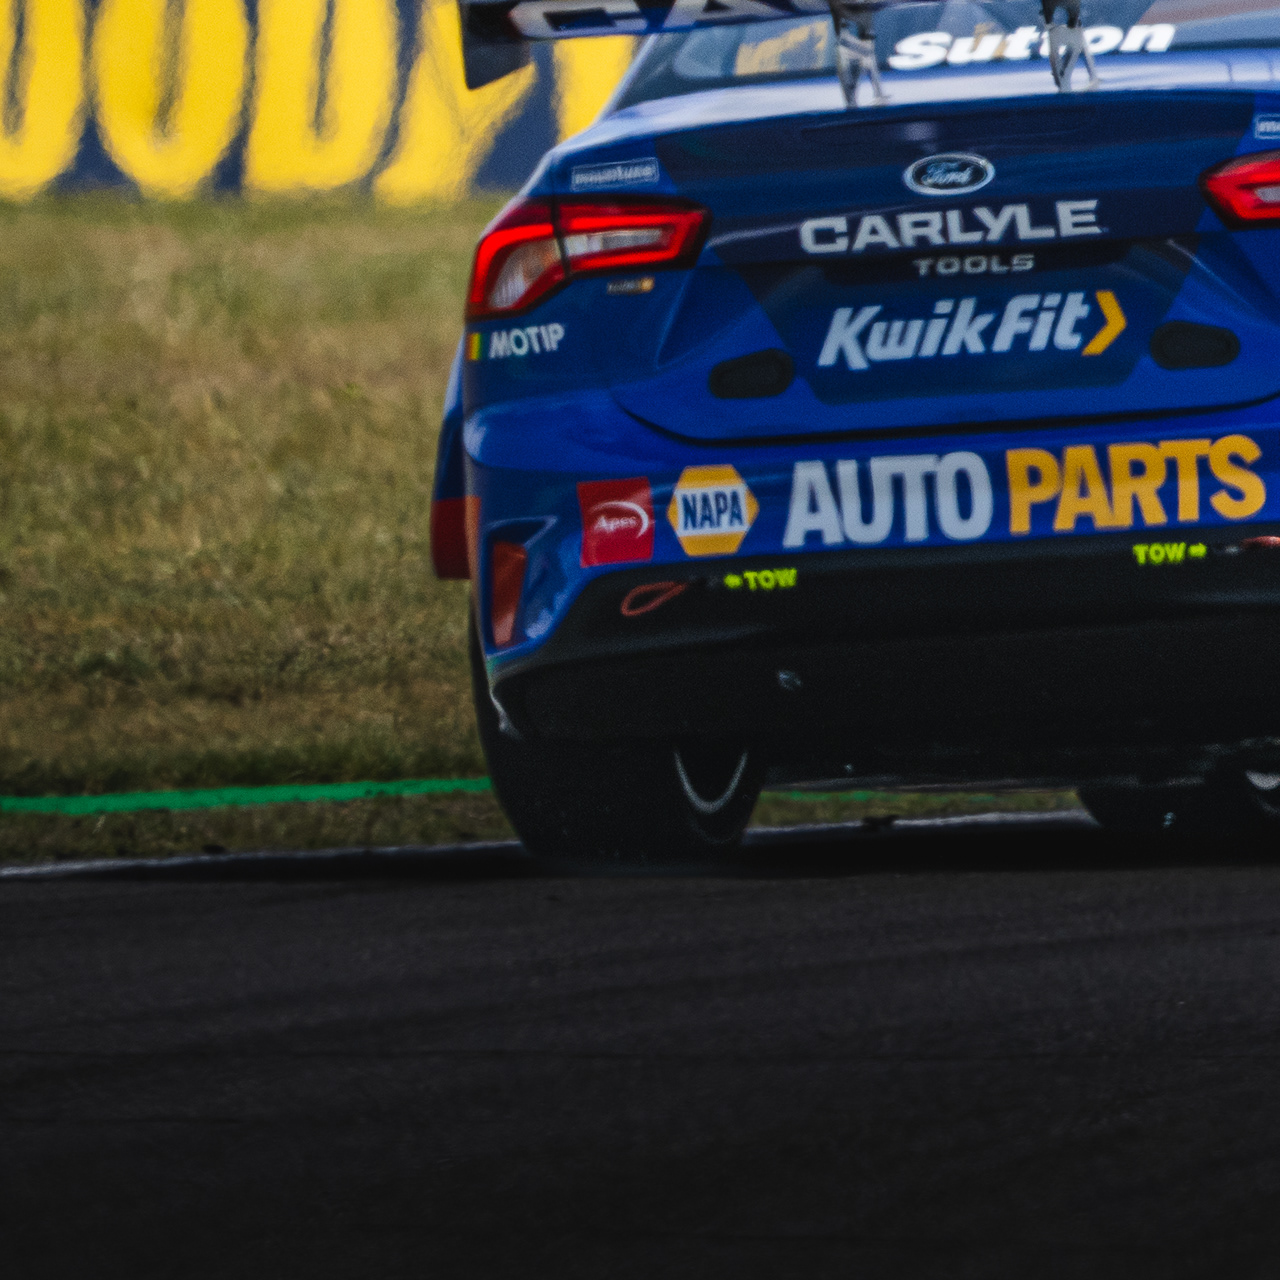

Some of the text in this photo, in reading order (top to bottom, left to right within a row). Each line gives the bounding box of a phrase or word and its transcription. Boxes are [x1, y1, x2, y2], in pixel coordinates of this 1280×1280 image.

[920, 161, 975, 186] Ford
[800, 199, 1102, 254] CARLYLE
[913, 253, 1036, 277] TOOLS
[488, 324, 566, 359] MOTIP
[783, 435, 1266, 548] AUTO PARTS
[682, 490, 744, 531] NAPA
[1133, 542, 1187, 565] TOW
[744, 568, 797, 590] TOW
